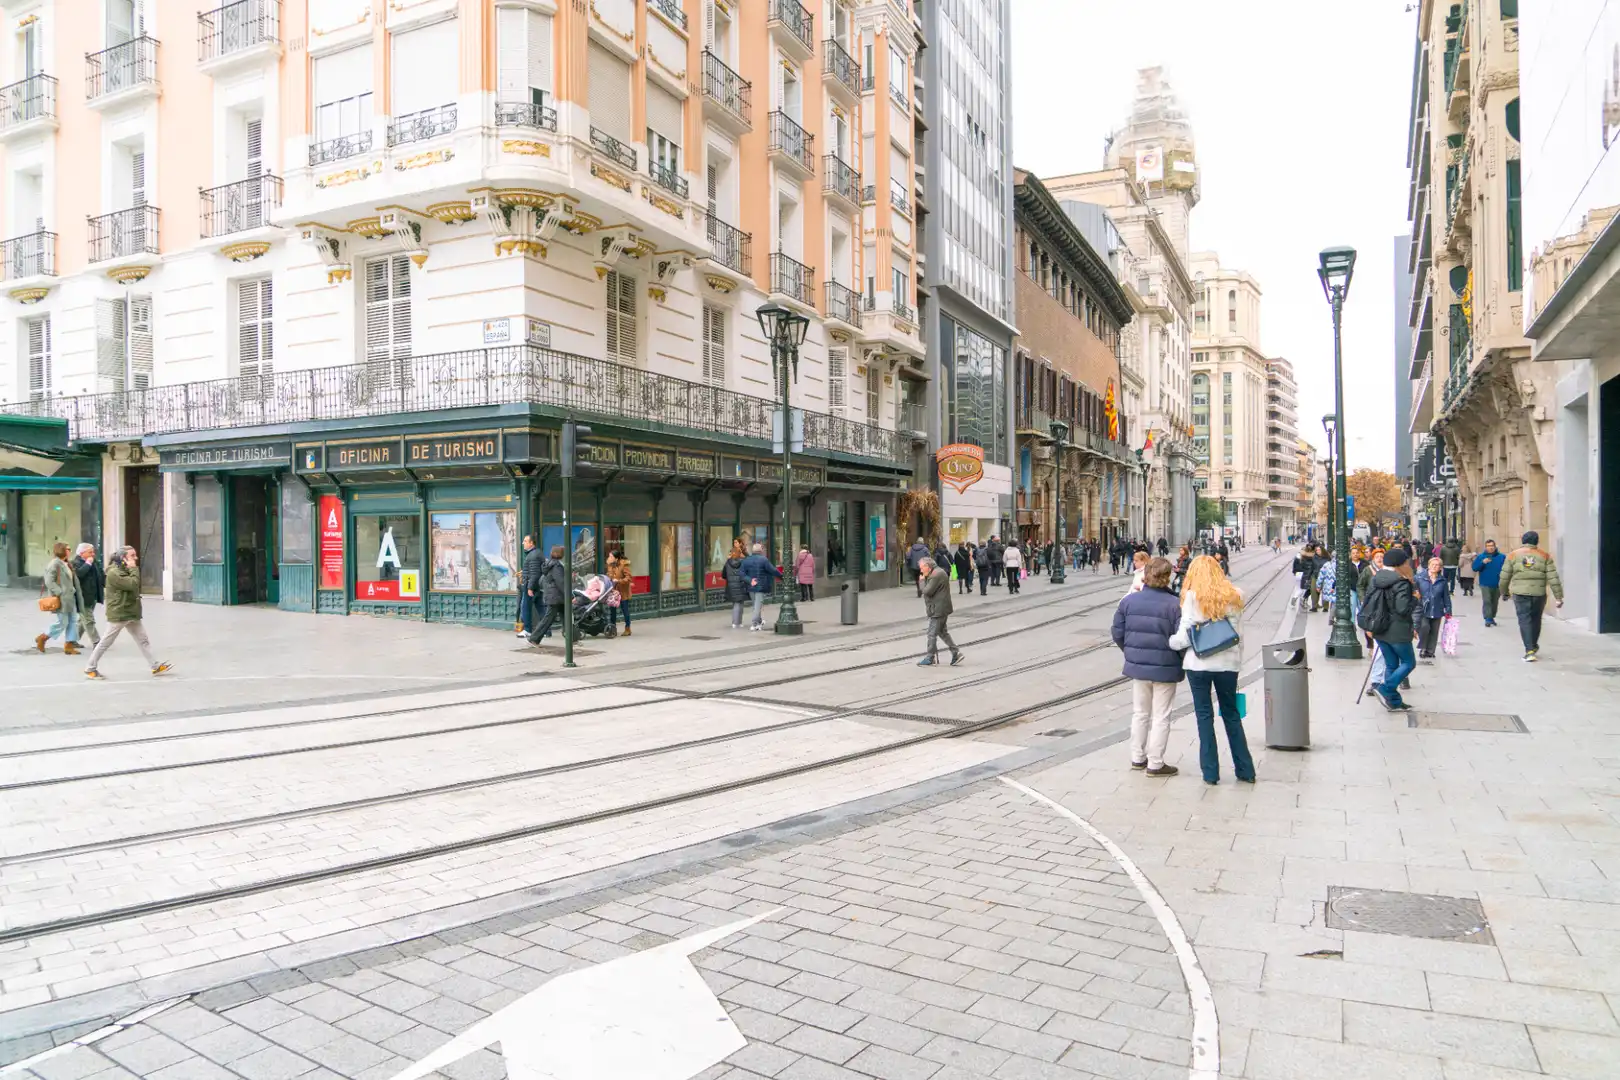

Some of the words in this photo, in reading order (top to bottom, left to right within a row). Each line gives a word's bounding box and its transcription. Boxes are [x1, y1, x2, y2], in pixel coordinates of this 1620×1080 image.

[175, 452, 211, 464] OFICINA
[215, 450, 228, 462] DE
[232, 447, 274, 460] TURISMO
[339, 448, 390, 464] OFICINA
[411, 444, 430, 460] DE
[435, 440, 494, 458] TURISMO
[625, 450, 671, 468] PROVINCIAL
[678, 456, 714, 472] ZARAGOZA
